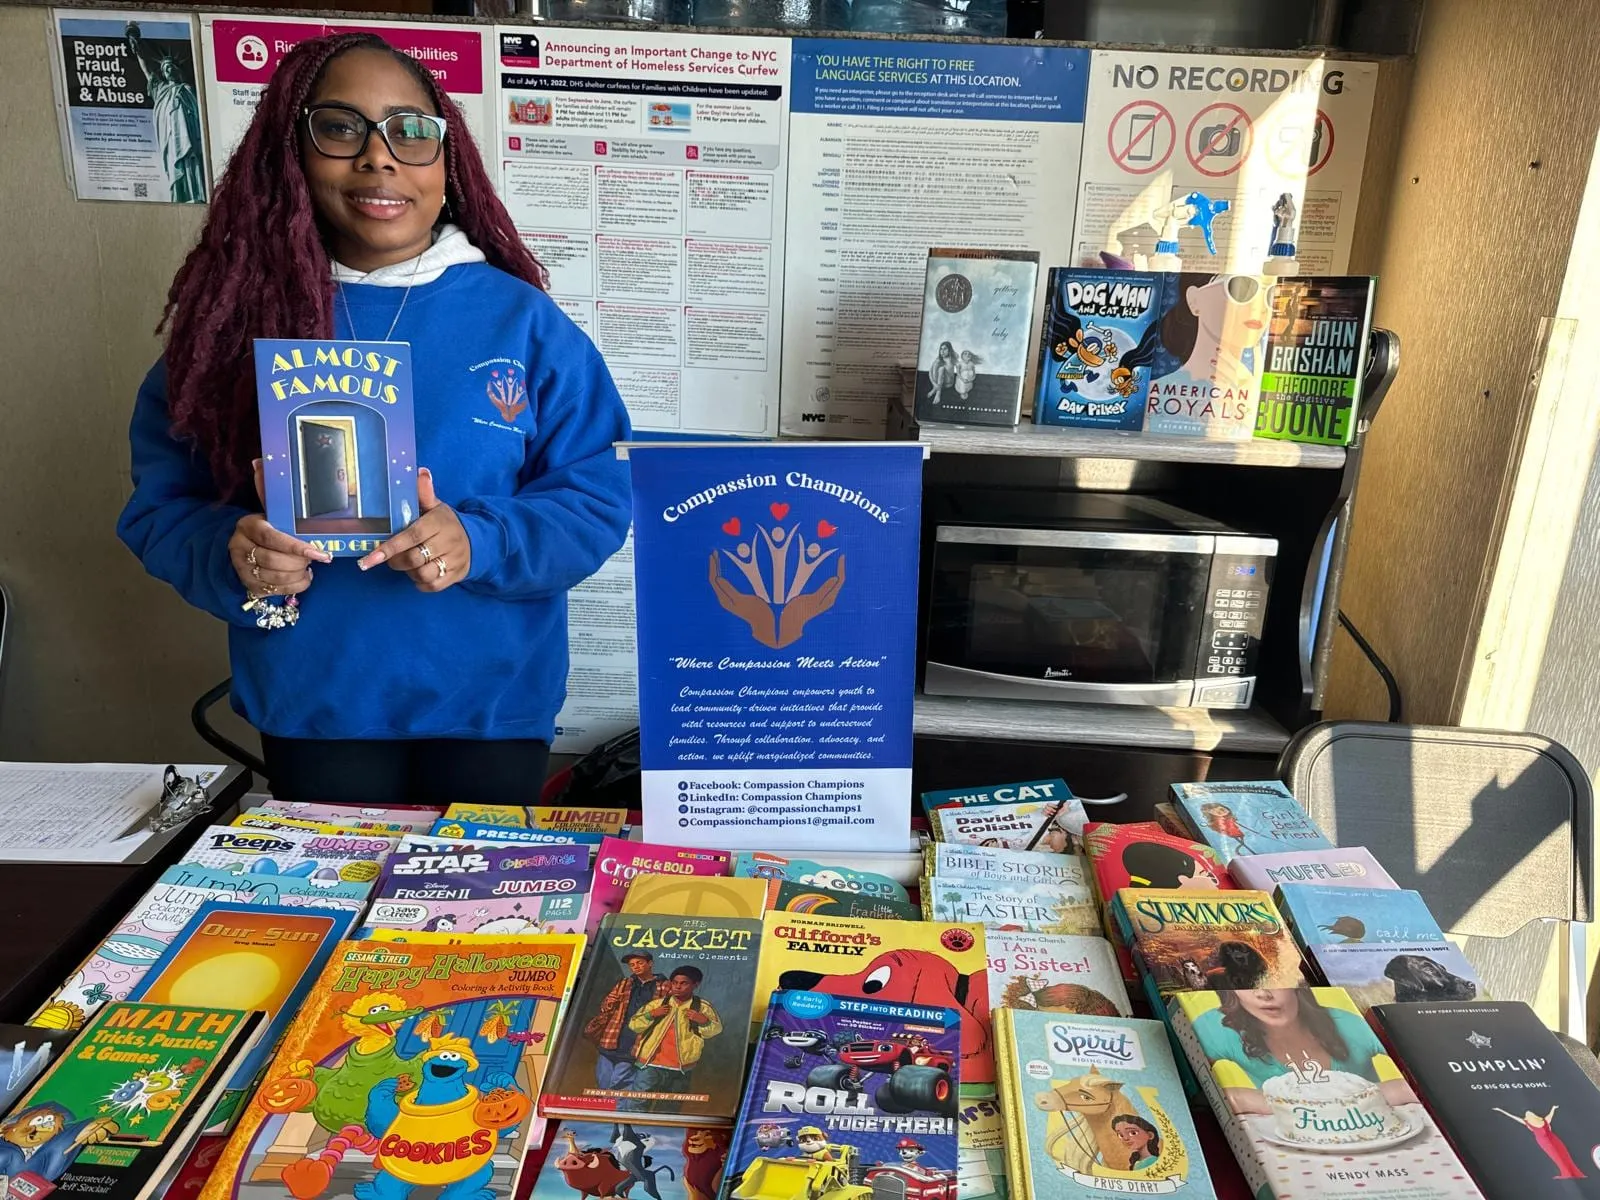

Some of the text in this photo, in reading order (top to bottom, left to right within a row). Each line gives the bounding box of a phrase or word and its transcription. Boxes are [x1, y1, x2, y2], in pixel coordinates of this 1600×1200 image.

[74, 41, 127, 58] Report
[545, 42, 776, 62] Announcing an Important Change to NYC
[76, 57, 125, 74] Fraud,
[545, 56, 612, 69] Department
[616, 59, 628, 69] of
[631, 60, 685, 72] Homeless
[688, 62, 734, 74] Services
[738, 64, 778, 76] Curfew
[816, 55, 975, 71] YOU HAVE THE RIGHT TO FREE
[77, 72, 127, 88] Waste
[815, 69, 1021, 87] LANGUAGE SERVICES AT THIS LOCATION.
[1112, 63, 1159, 90] NO
[80, 88, 144, 104] & Abuse
[525, 78, 537, 86] July
[607, 82, 630, 90] curfews
[642, 84, 666, 92] Families
[682, 86, 708, 94] Children
[741, 88, 768, 96] updated:
[1067, 282, 1151, 308] DOG MAN
[1305, 320, 1357, 348] JOHN
[271, 347, 402, 378] ALMOST
[1270, 345, 1353, 376] GRISHAM
[270, 374, 400, 405] FAMOUS
[1150, 383, 1248, 401] AMERICAN
[1275, 375, 1349, 397] THEODORE
[802, 413, 826, 422] NYC
[1147, 398, 1247, 420] ROYALS
[1254, 399, 1343, 440] BOONE
[662, 471, 891, 524] Compassion Champions
[679, 685, 875, 698] Compassion Champions empowers youth to
[671, 702, 883, 714] lead community-driven initiatives that provide
[681, 718, 872, 730] vital resources and support to underserved
[689, 780, 865, 792] Facebook: Compassion Champions
[949, 783, 1055, 803] THE CAT
[690, 792, 862, 803] LinkedIn: Compassion Champions
[455, 809, 620, 825] RAYA JUMBO
[690, 804, 862, 815] Instagram: @compassionchamps1
[690, 816, 875, 827] Compassionchampions1@gmail.com
[955, 813, 1031, 825] David and
[958, 822, 1033, 834] Goliath
[210, 833, 391, 852] Peeps JUMBO
[476, 829, 576, 845] PRESCHOOL
[393, 854, 489, 869] STAR
[631, 856, 694, 875] BIG & BOLD
[945, 857, 1082, 880] BIBLE STORIES
[1265, 862, 1368, 883] MUFFLED
[394, 879, 576, 900] FROZEN II JUMBO
[830, 879, 895, 894] GOOD
[548, 897, 573, 908] 112
[971, 891, 1039, 905] The Story of
[965, 902, 1059, 922] EASTER
[1136, 899, 1280, 935] SURVIVORS
[201, 923, 320, 942] Our Sun
[826, 921, 865, 929] BRIDWELL
[612, 924, 751, 951] JACKET
[773, 925, 882, 946] Clifford's
[1376, 928, 1439, 941] call me
[658, 952, 748, 961] Andrew Clements
[786, 940, 868, 956] FAMILY
[346, 952, 409, 965] SESAME STREET
[331, 952, 561, 993] Happy Halloween
[508, 971, 556, 982] JUMBO
[451, 984, 488, 995] Coloring
[498, 984, 531, 993] Activity
[533, 984, 555, 992] Book
[839, 1001, 943, 1020] STEP INTO READING
[103, 1007, 236, 1034] MATH
[92, 1029, 218, 1052] Tricks, Puzzles
[1052, 1025, 1134, 1061] Spirit
[77, 1046, 159, 1065] & Games
[1072, 1057, 1102, 1065] RIDING
[1448, 1058, 1546, 1072] DUMPLIN'
[763, 1080, 874, 1116] ROLL
[824, 1115, 954, 1135] TOGETHER!
[1293, 1106, 1385, 1133] Finally
[380, 1129, 492, 1165] COOKIES
[1326, 1168, 1409, 1181] WENDY MASS
[1094, 1177, 1160, 1193] PRU'S DIARY
